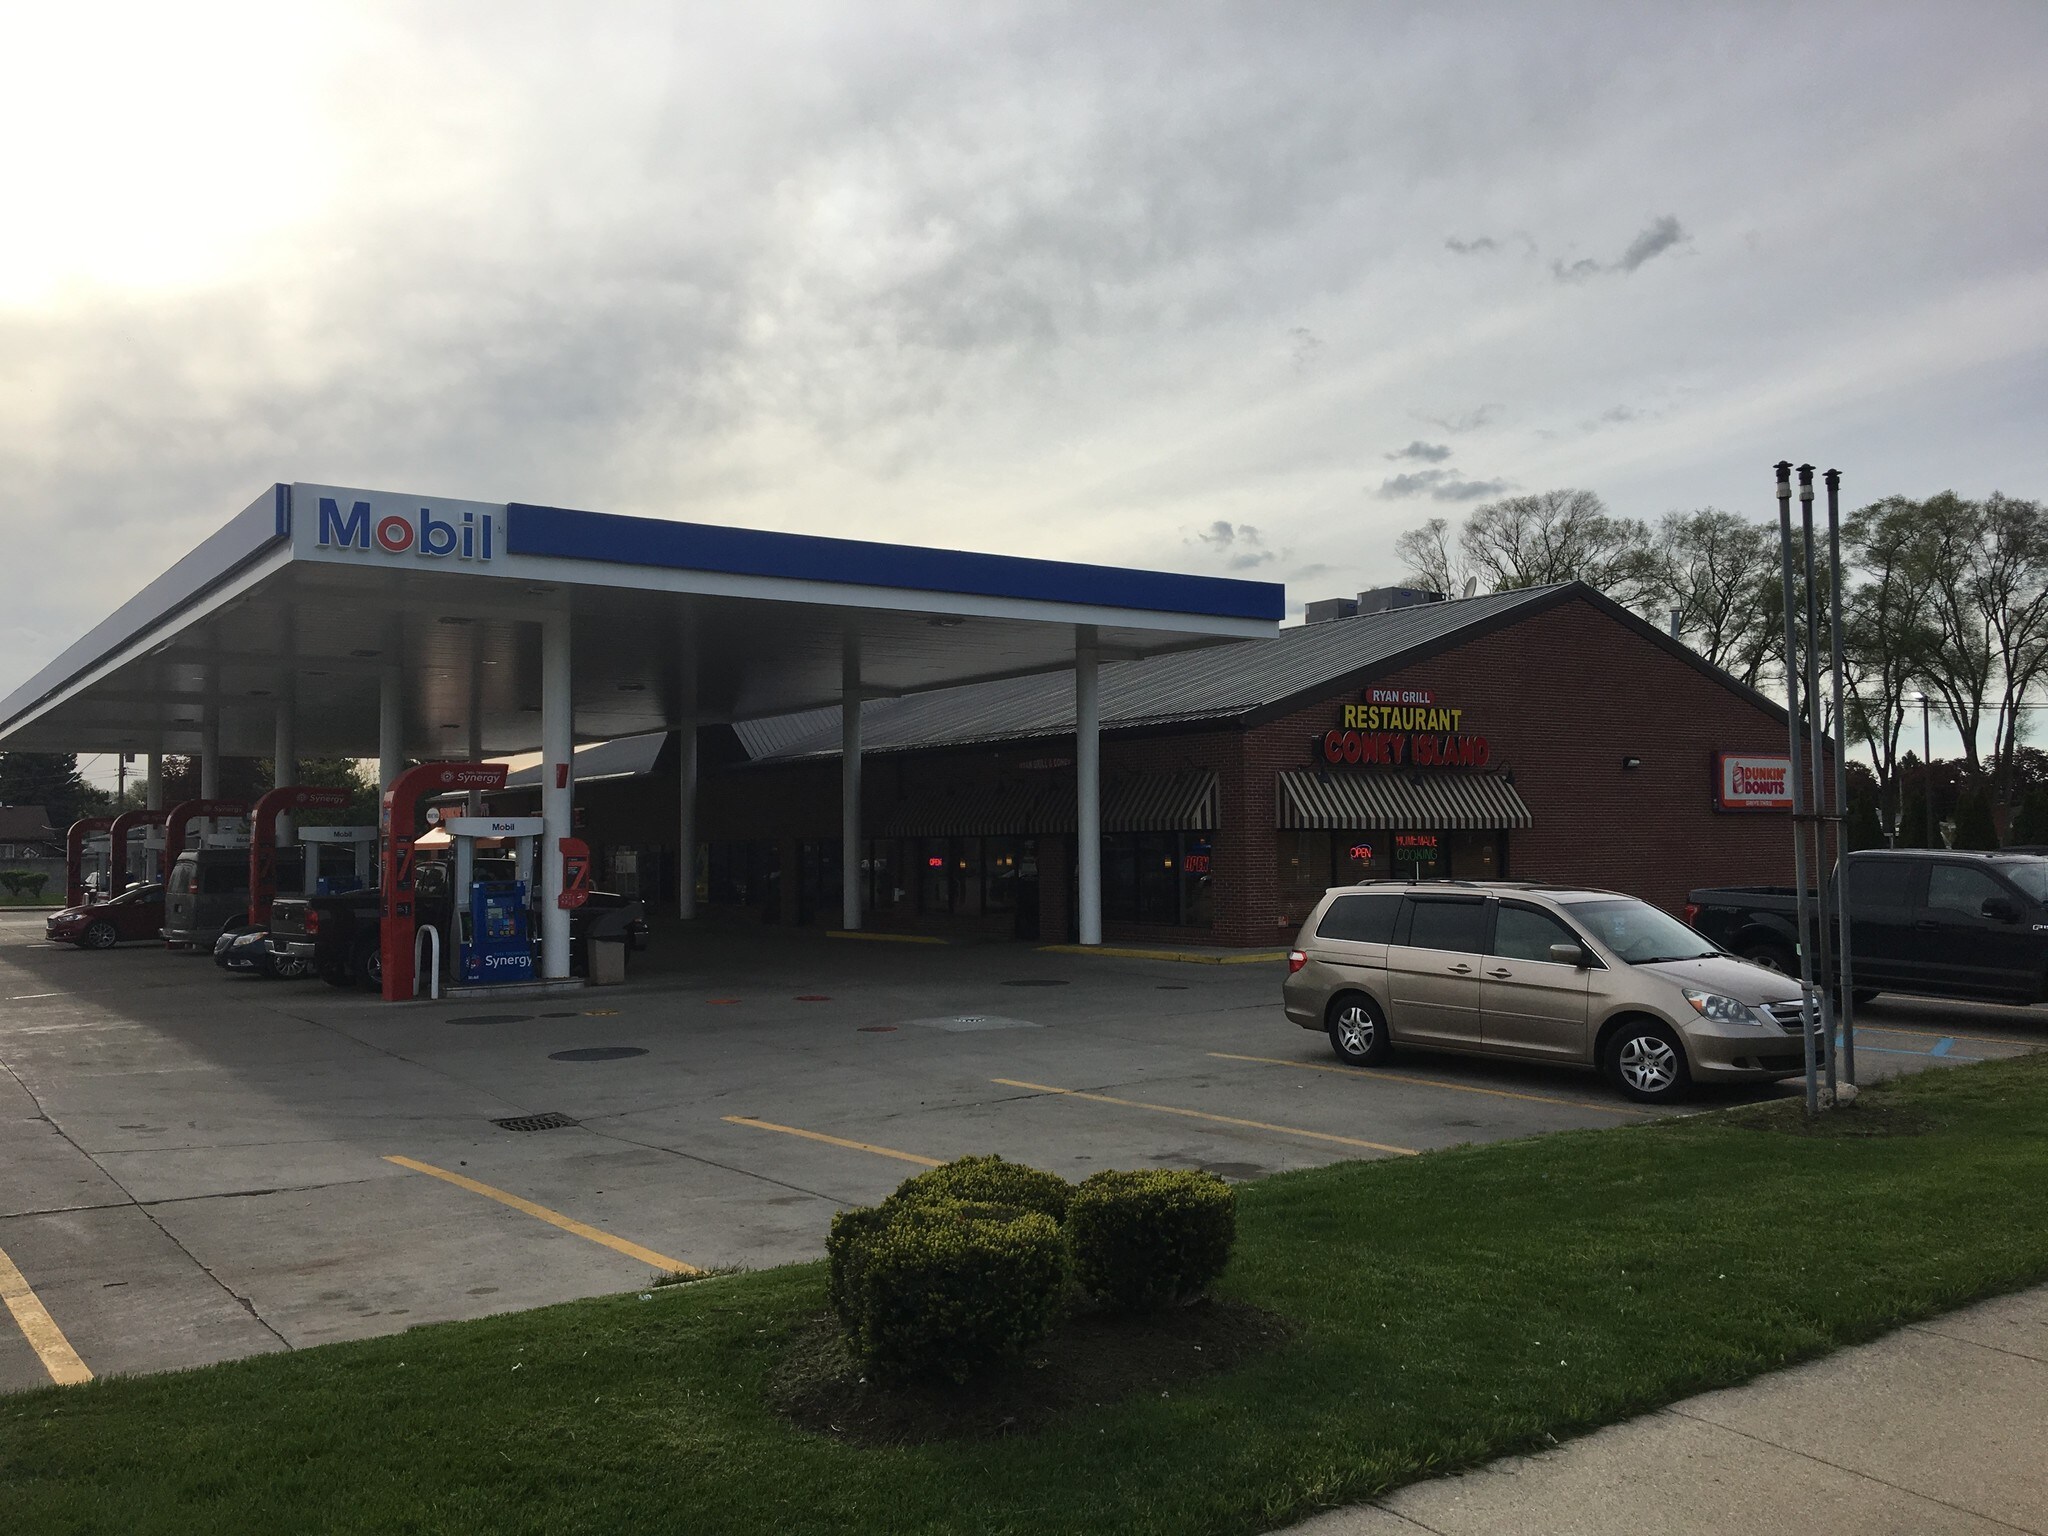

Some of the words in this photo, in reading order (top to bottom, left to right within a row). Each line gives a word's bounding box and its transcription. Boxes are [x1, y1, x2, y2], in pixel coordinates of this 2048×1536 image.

[318, 497, 493, 560] Mobil
[1372, 689, 1400, 703] RYAN
[1401, 690, 1431, 705] GRILL
[1343, 704, 1463, 731] RESTAURANT
[1323, 729, 1406, 765] CONEY
[1410, 733, 1490, 766] ISLAND
[457, 772, 501, 784] Synergy
[1745, 767, 1786, 780] DUNKIN'
[1745, 781, 1785, 795] DONUTS
[309, 793, 345, 804] Synergy
[492, 823, 515, 831] Mobil
[1350, 847, 1372, 859] OPEN
[1396, 848, 1438, 861] COOKING
[1184, 855, 1210, 872] OPEN
[485, 955, 532, 969] Synergy
